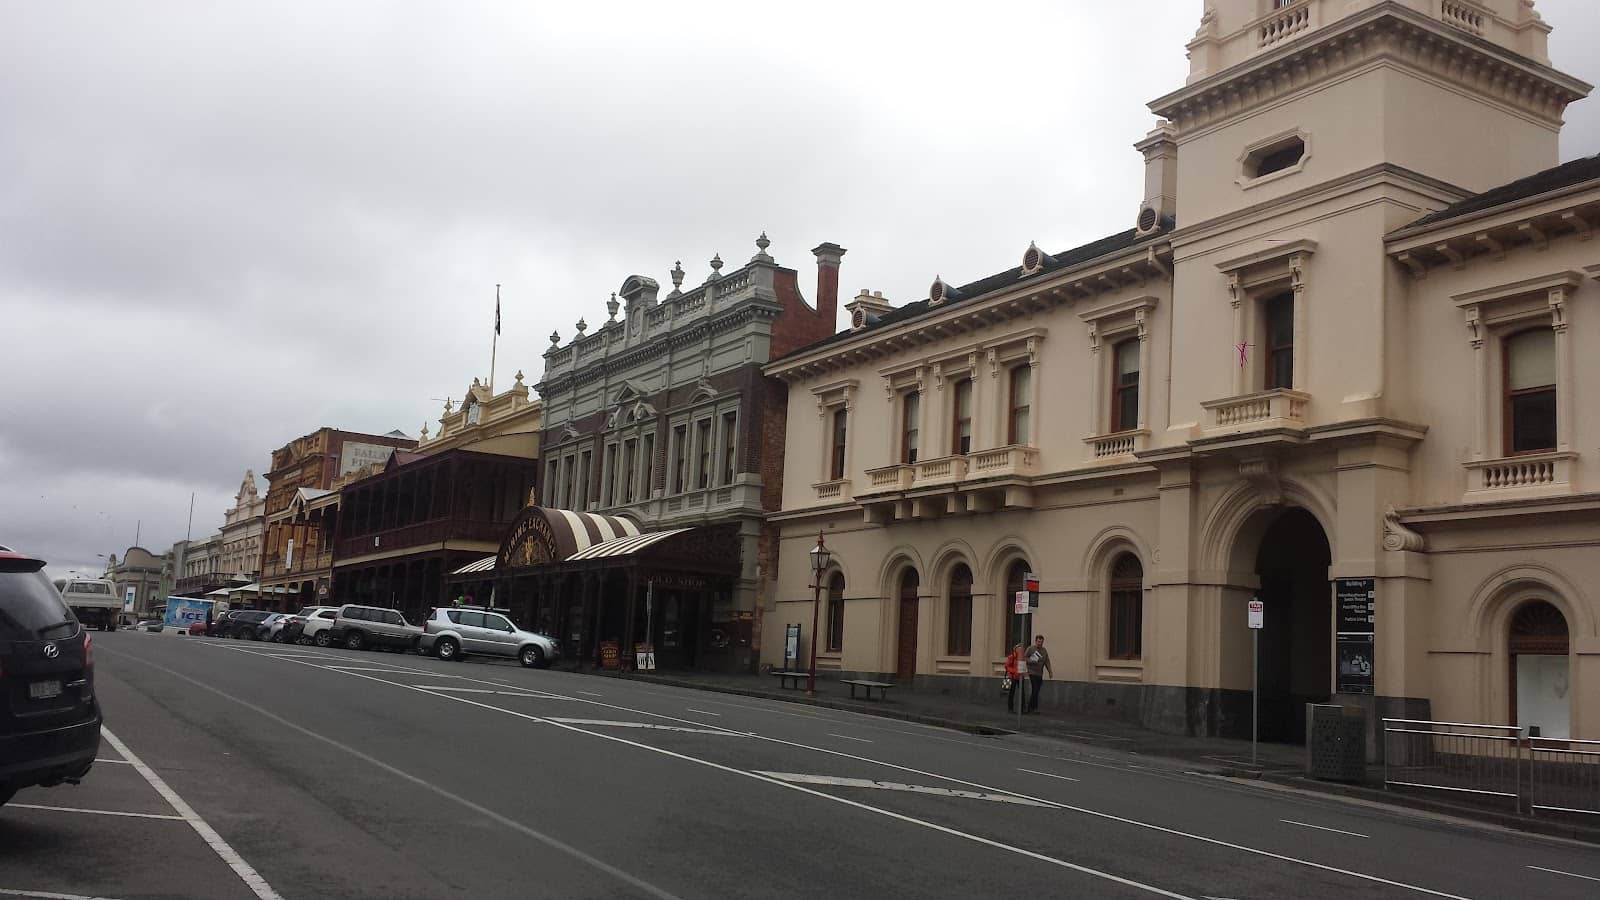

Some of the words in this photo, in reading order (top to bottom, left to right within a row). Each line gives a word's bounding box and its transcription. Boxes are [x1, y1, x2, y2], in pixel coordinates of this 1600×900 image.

[504, 521, 527, 565] MINING
[528, 517, 557, 559] EXCHANGE
[181, 612, 204, 621] ICE
[637, 656, 655, 665] OPN
